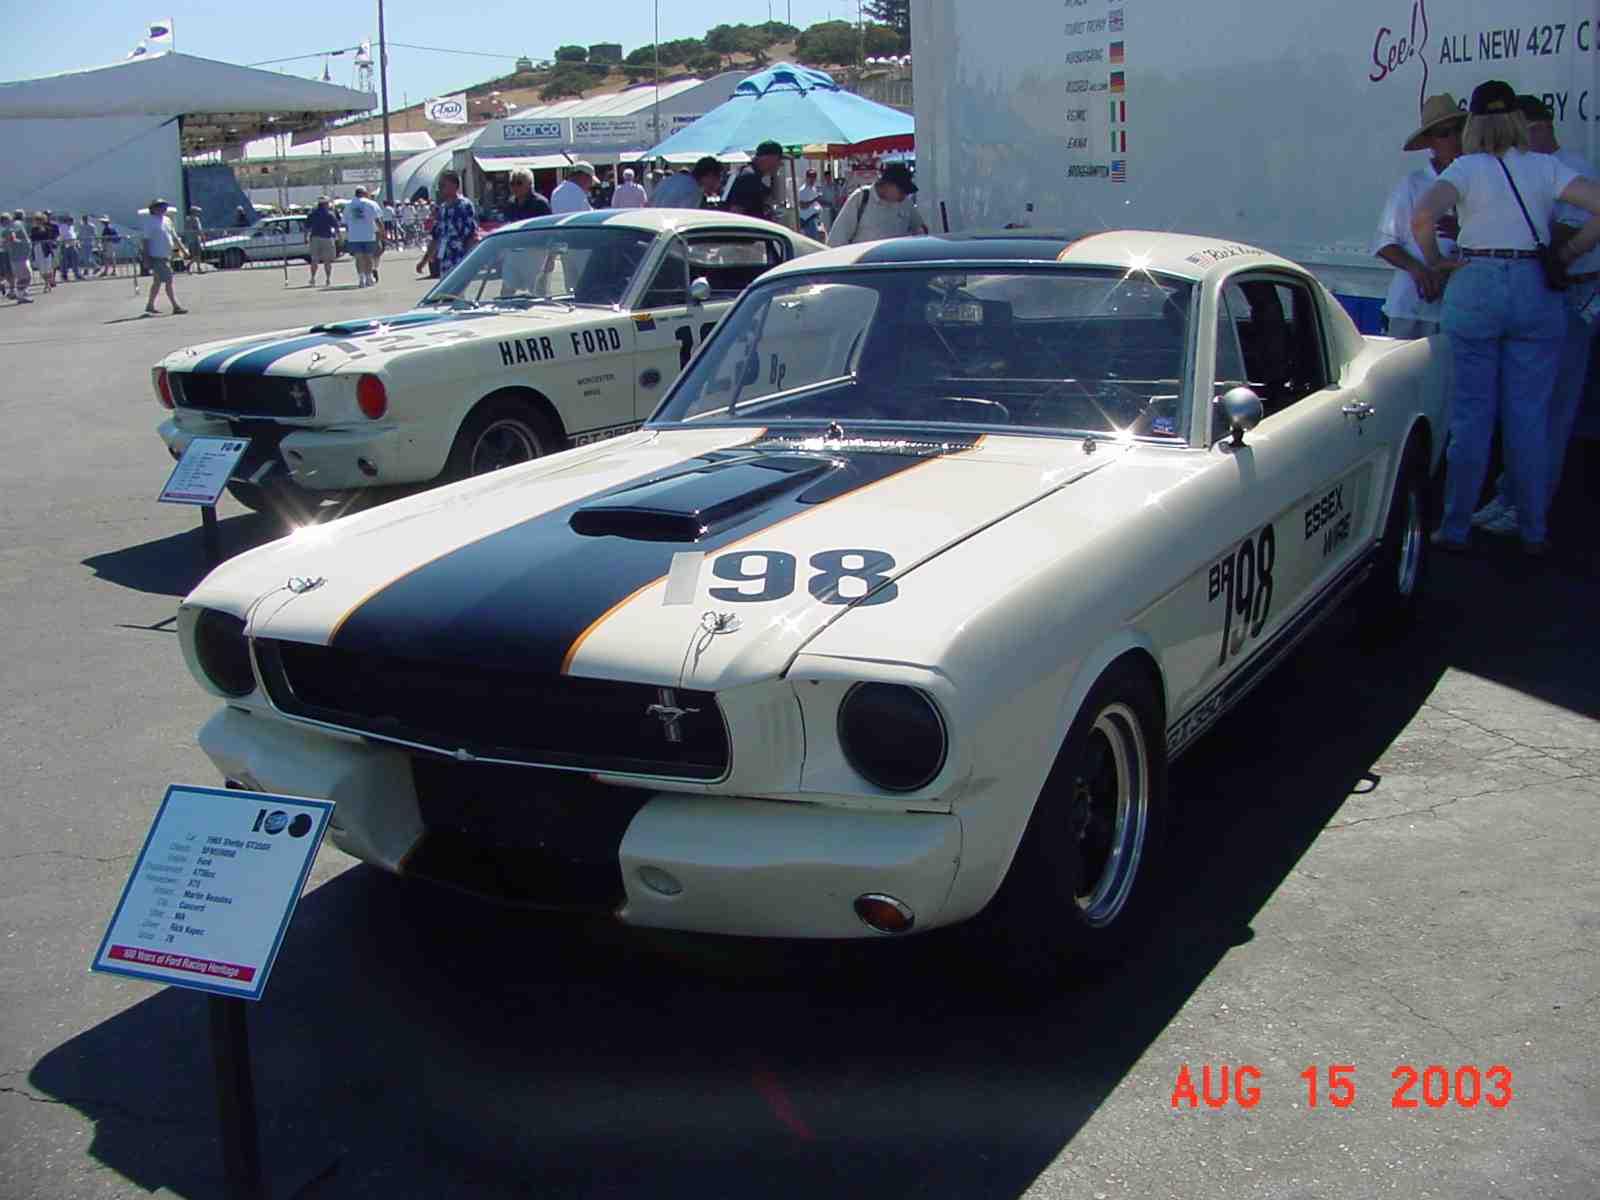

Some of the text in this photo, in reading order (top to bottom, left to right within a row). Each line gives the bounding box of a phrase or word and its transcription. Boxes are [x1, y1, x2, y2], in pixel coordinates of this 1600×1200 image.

[1440, 36, 1472, 64] ALL
[1479, 29, 1520, 59] NEW
[1526, 24, 1566, 55] 427
[498, 327, 621, 366] HARR FORD
[1305, 484, 1344, 540] ESSEX
[165, 955, 181, 967] Ford
[181, 958, 208, 974] Racing
